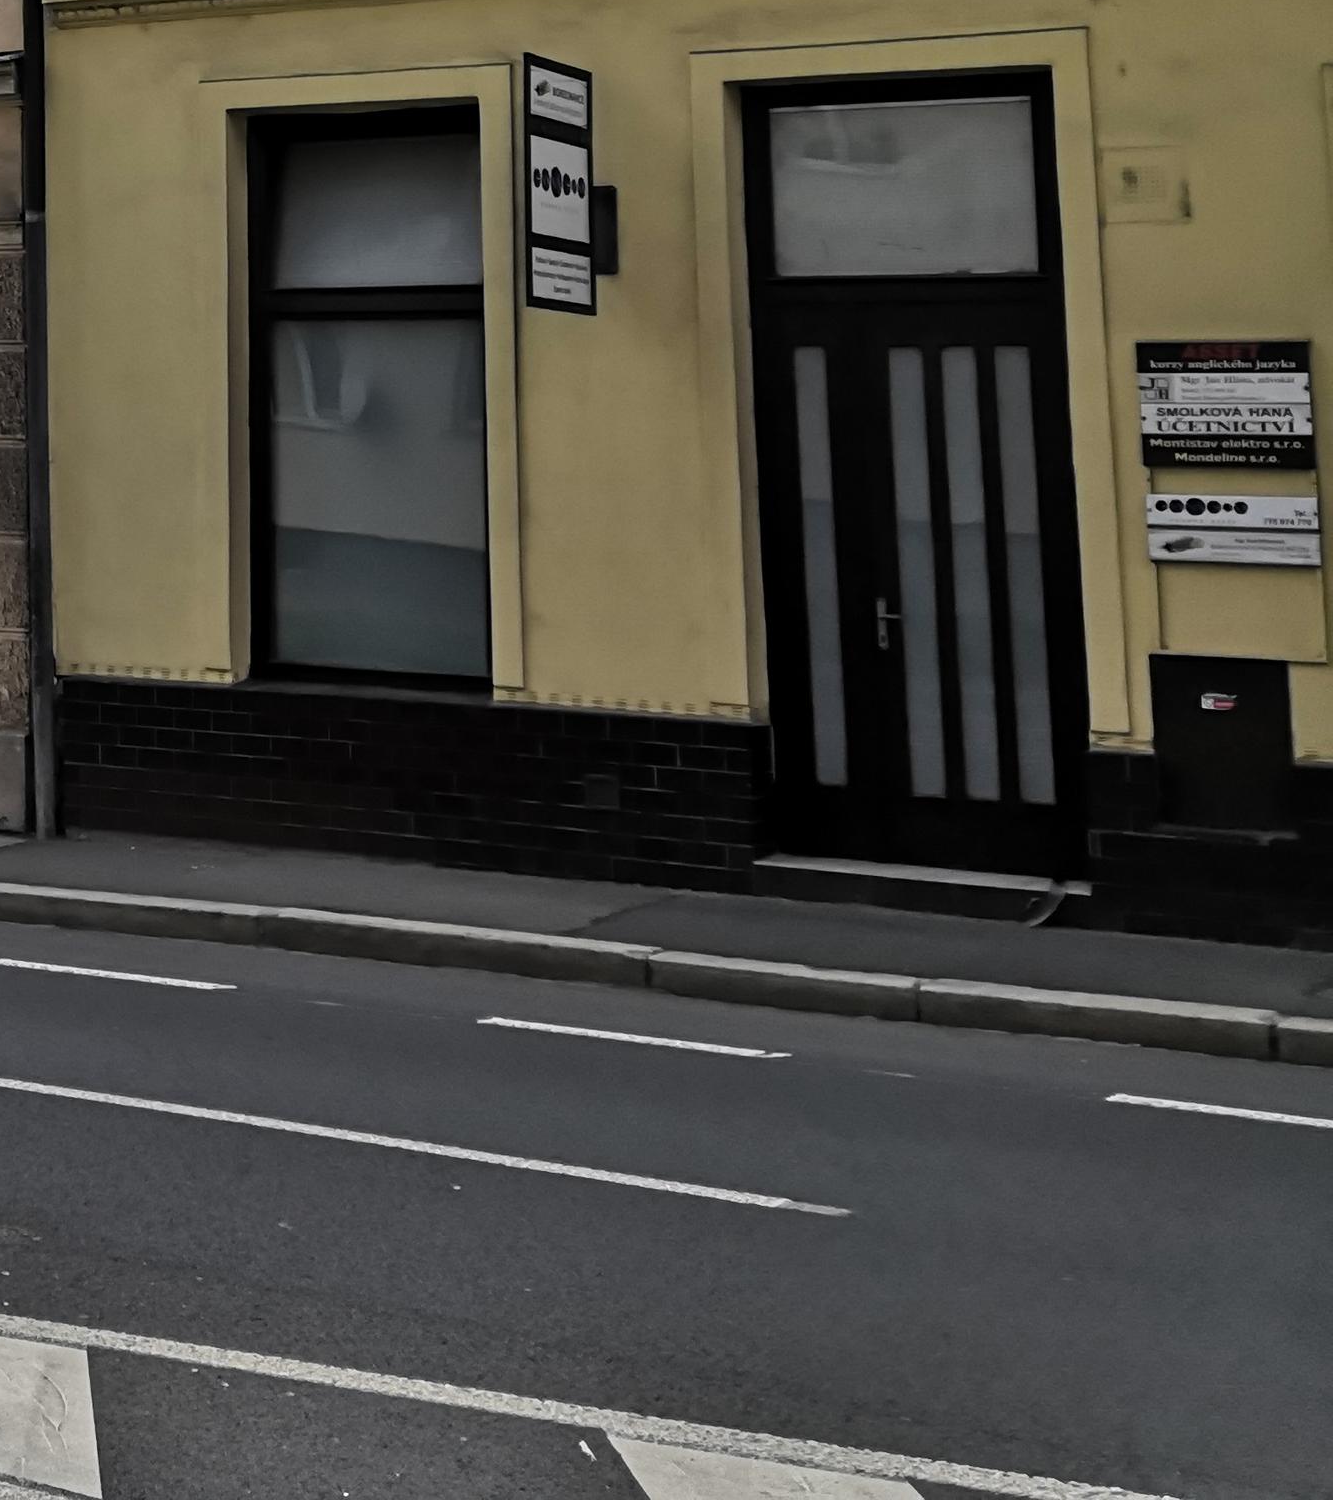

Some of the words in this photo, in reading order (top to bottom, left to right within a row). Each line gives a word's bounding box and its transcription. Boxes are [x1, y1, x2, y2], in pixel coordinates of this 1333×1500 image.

[1150, 359, 1184, 371] kurzy
[1187, 359, 1253, 371] anglického
[1255, 359, 1297, 371] jazyka
[1156, 404, 1243, 417] SMOLKOVÁ
[1248, 406, 1294, 418] HANA
[1157, 417, 1295, 433] ÚČETNICTVÍ
[1149, 438, 1219, 448] Montistav
[1221, 438, 1270, 449] elektro
[1273, 441, 1306, 449] s.r.o.
[1174, 452, 1247, 463] Mondeline
[1249, 455, 1281, 464] s.r.o.
